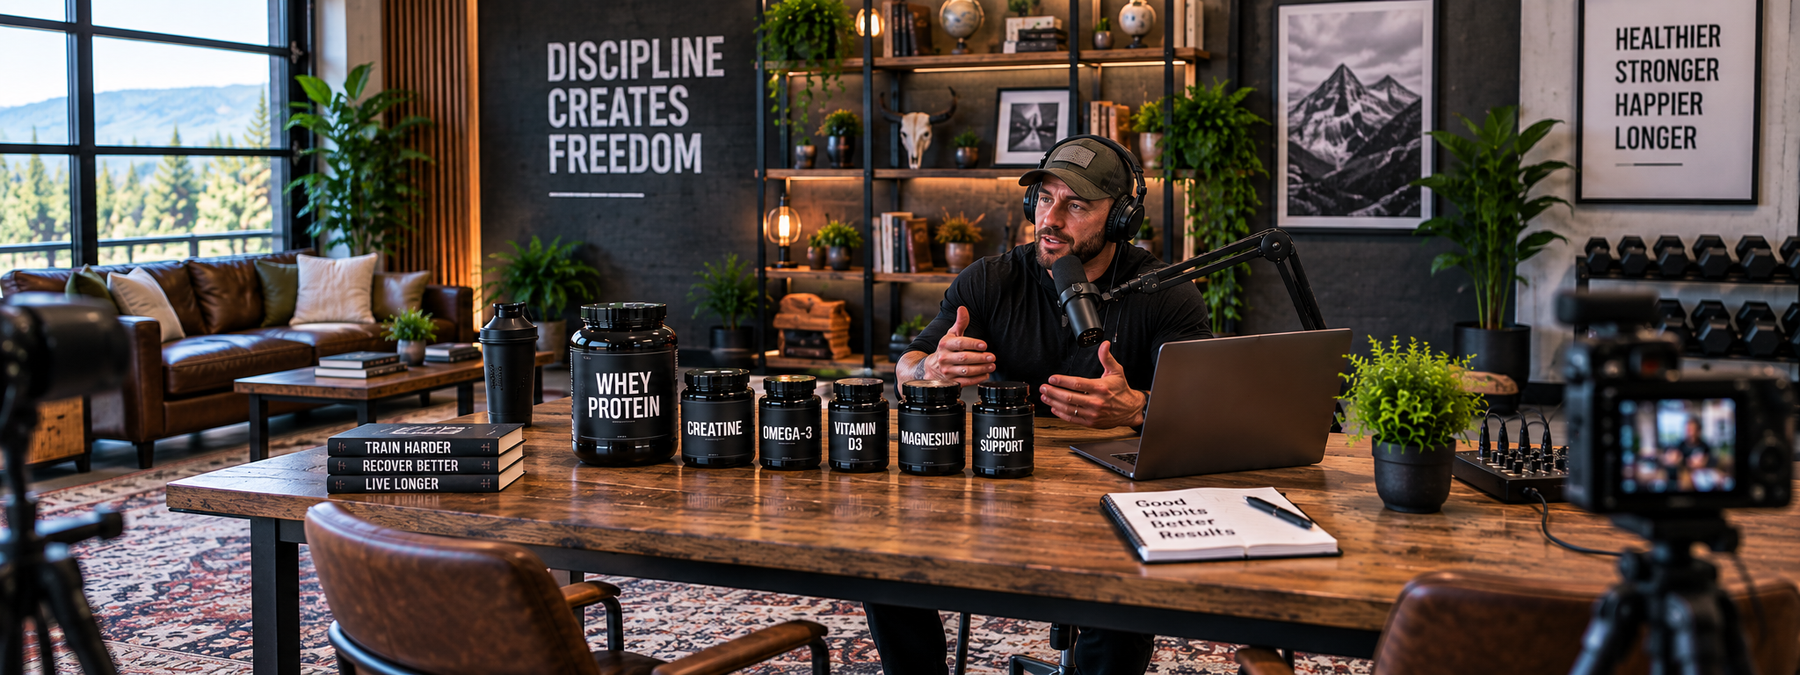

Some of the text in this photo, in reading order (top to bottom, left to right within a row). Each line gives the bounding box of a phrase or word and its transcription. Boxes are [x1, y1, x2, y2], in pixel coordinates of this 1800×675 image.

[1616, 24, 1721, 51] HEALTHIER
[548, 36, 724, 81] DISCIPLINE
[1616, 58, 1718, 83] STRONGER
[549, 85, 688, 128] CREATES
[1616, 92, 1702, 116] HAPPIER
[1616, 126, 1696, 149] LONGER
[549, 133, 701, 173] FREEDOM
[595, 371, 652, 395] WHEY
[589, 396, 659, 419] PROTEIN
[688, 421, 742, 436] CREATINE
[763, 426, 812, 440] OMEGA-3
[835, 422, 875, 435] VITAMIN
[986, 426, 1017, 440] JOINT
[849, 438, 862, 450] D3
[902, 431, 958, 446] MAGNESIUM
[981, 439, 1023, 452] SUPPORT
[365, 441, 450, 453] TRAIN HARDER
[363, 460, 458, 471] RECOVER BETTER
[366, 478, 438, 490] LIVE LONGER
[1135, 498, 1187, 508] Good
[1142, 508, 1209, 518] Habits
[1150, 519, 1215, 529] Better
[1159, 528, 1237, 540] Results
